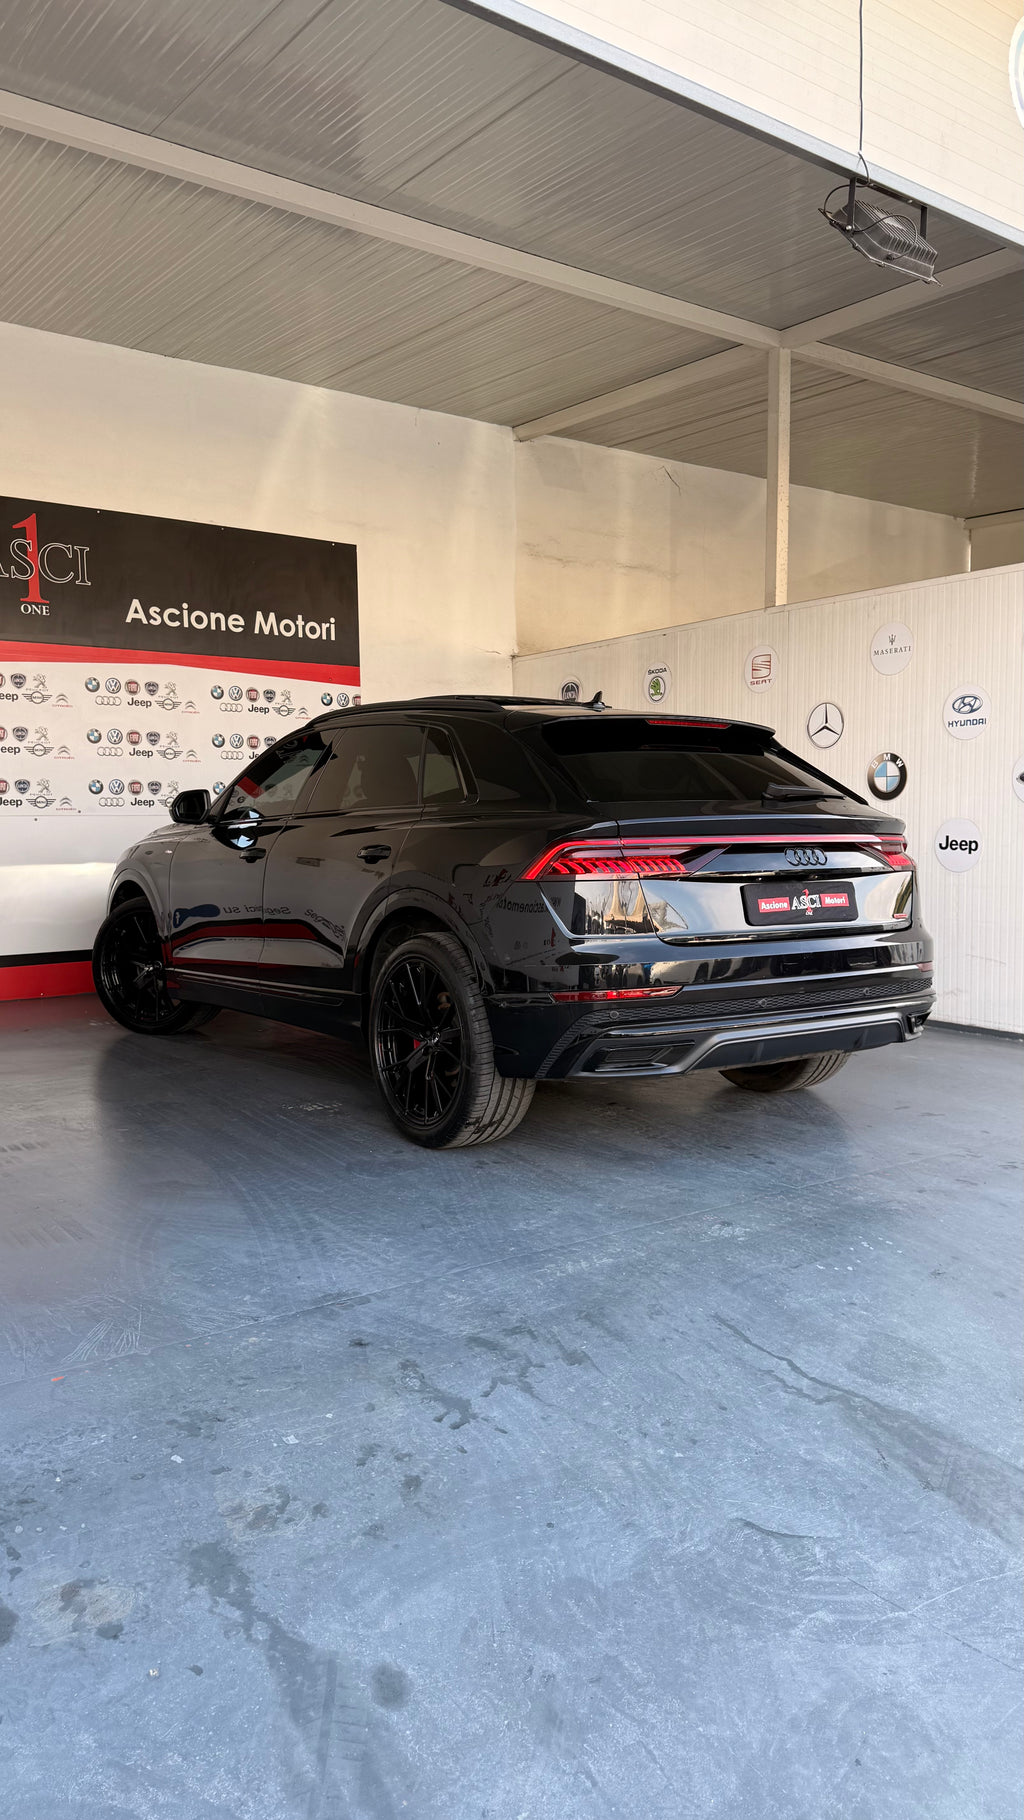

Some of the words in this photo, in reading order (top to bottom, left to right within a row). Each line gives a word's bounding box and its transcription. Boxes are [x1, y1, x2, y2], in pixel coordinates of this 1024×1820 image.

[0, 538, 91, 586] SCI
[20, 603, 50, 616] ONE
[125, 598, 245, 633] Ascione
[254, 610, 336, 641] Motori
[873, 645, 912, 656] MASERATI
[749, 678, 772, 686] SEAT
[0, 692, 19, 702] eep
[127, 697, 152, 709] Jeep
[248, 704, 270, 715] Jeep
[947, 718, 987, 728] HYUNDAI
[0, 745, 21, 755] eep
[129, 747, 154, 759] Jeep
[871, 753, 904, 770] BMW
[130, 797, 155, 808] Jeep
[939, 835, 979, 855] Jeep
[761, 901, 788, 910] Ascione
[791, 894, 822, 910] ASCI
[824, 896, 846, 905] Motori
